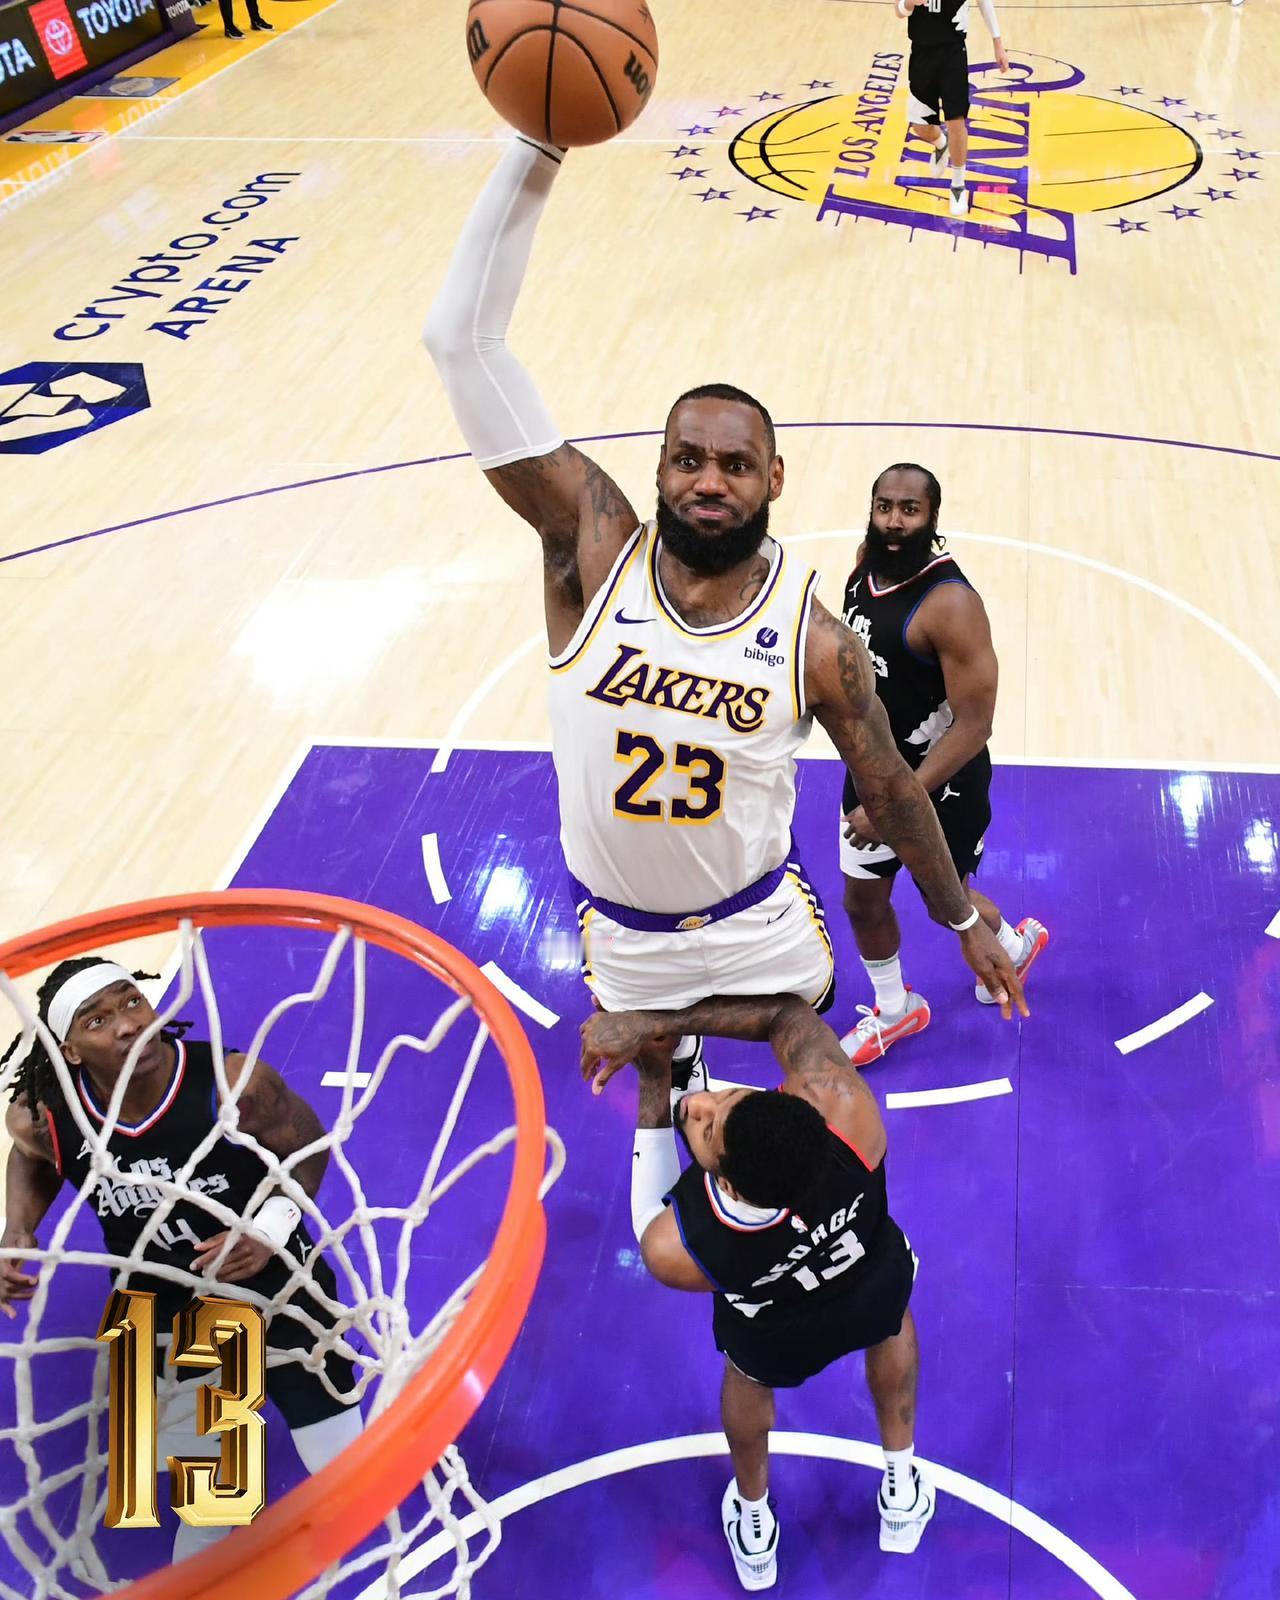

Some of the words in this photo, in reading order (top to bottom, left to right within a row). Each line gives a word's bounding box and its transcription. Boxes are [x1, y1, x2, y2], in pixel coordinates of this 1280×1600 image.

[0, 38, 36, 84] TA
[851, 51, 905, 136] ANGELES
[834, 135, 879, 179] LOS
[53, 171, 302, 341] crypto.com
[145, 235, 301, 341] ARENA
[585, 642, 773, 734] LAKERS
[743, 646, 786, 667] bibigo
[612, 728, 729, 826] 23
[791, 1229, 866, 1292] 13
